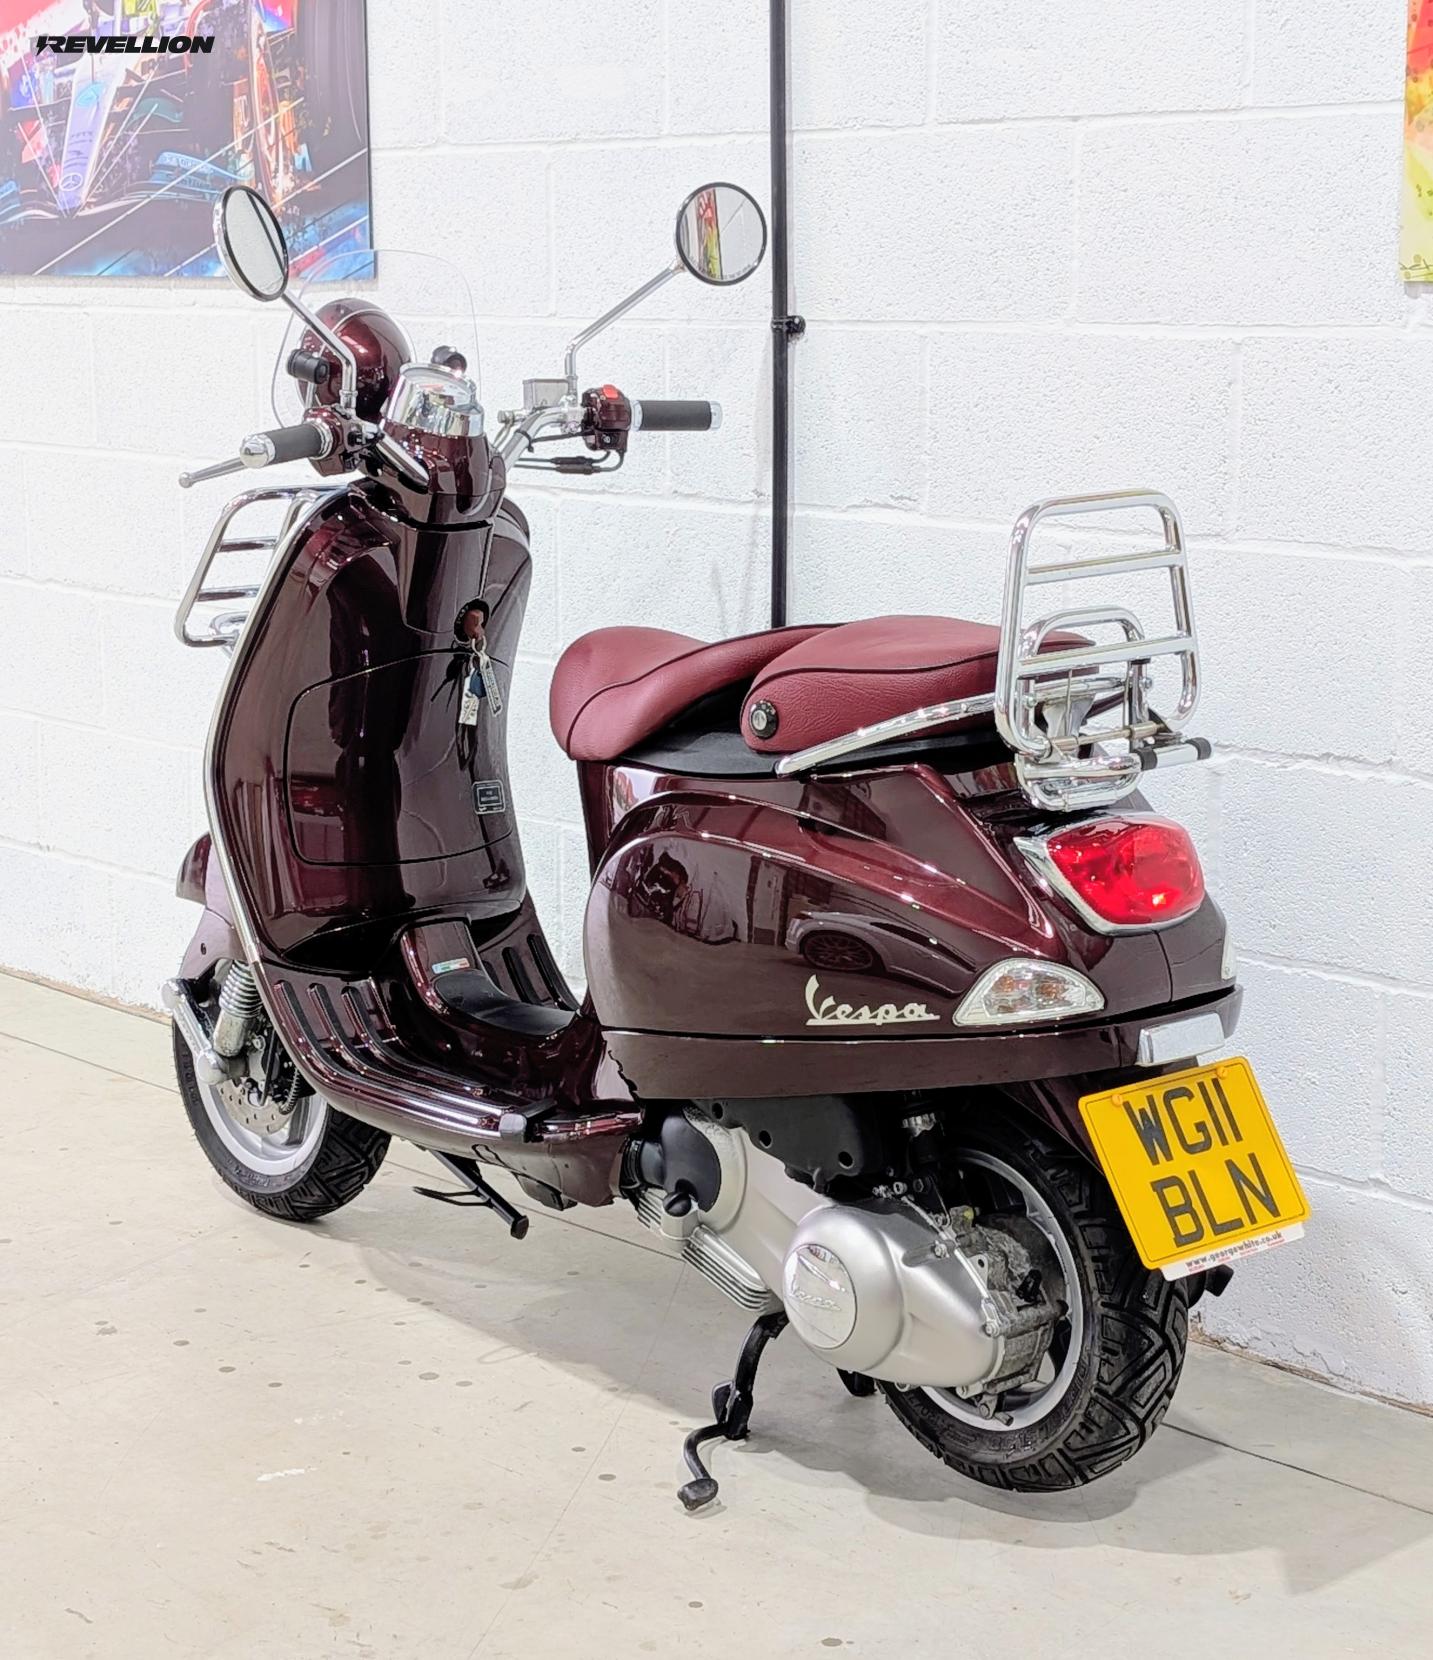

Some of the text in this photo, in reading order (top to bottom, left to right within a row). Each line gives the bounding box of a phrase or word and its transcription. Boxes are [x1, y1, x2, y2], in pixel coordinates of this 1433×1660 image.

[805, 974, 941, 1026] Vespa
[1123, 1078, 1243, 1166] WG11
[1150, 1152, 1281, 1248] BLN
[1185, 1232, 1283, 1266] www.georgewhite.co.uk
[789, 1274, 843, 1311] Vespa
